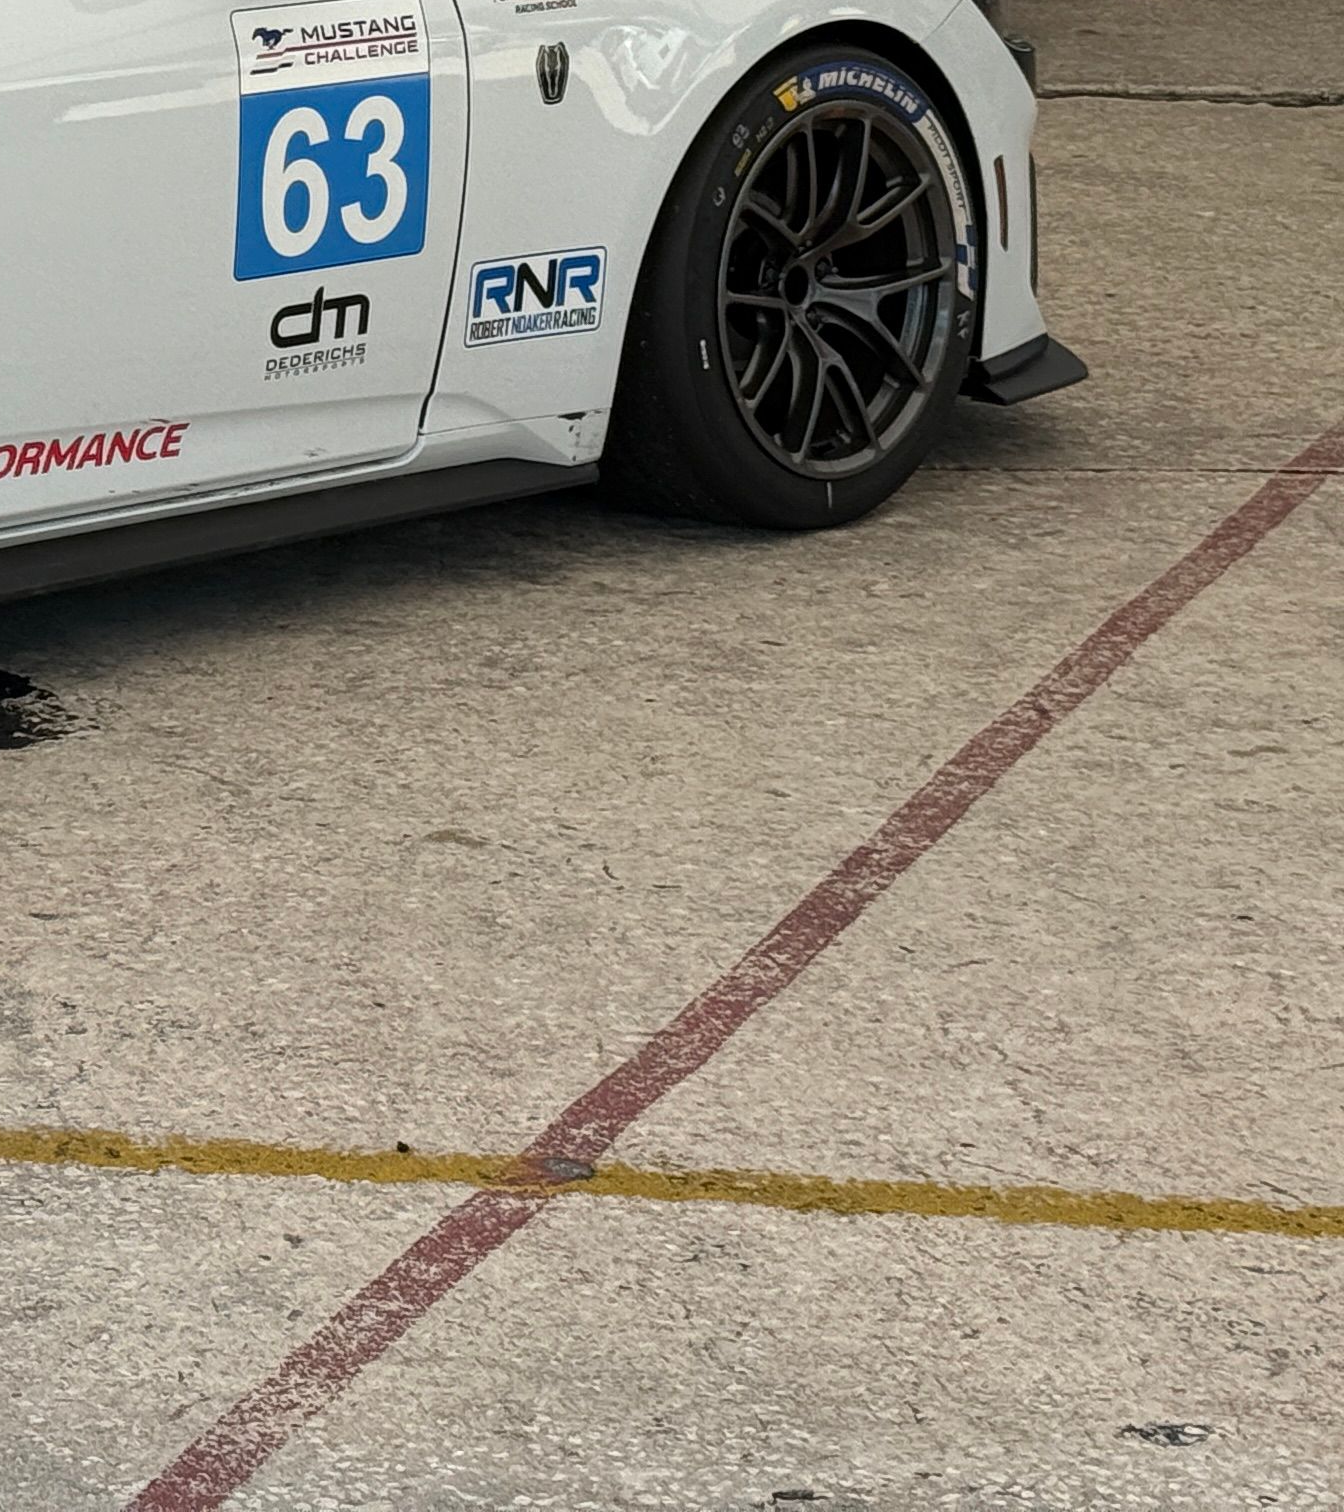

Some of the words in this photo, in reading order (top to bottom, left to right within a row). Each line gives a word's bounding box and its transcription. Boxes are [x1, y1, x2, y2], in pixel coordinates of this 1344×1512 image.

[515, 2, 544, 13] RACING
[301, 15, 415, 43] MUSTANG
[304, 40, 419, 65] CHALLENGE
[817, 66, 921, 115] MICHELIN
[263, 95, 408, 257] 63
[927, 122, 947, 160] PILOT
[946, 156, 967, 211] SPORT
[472, 254, 600, 318] RNR
[469, 318, 511, 341] ROBERT
[511, 311, 552, 335] NOAKER
[553, 306, 598, 329] RACING
[265, 343, 367, 372] DEDERICHS
